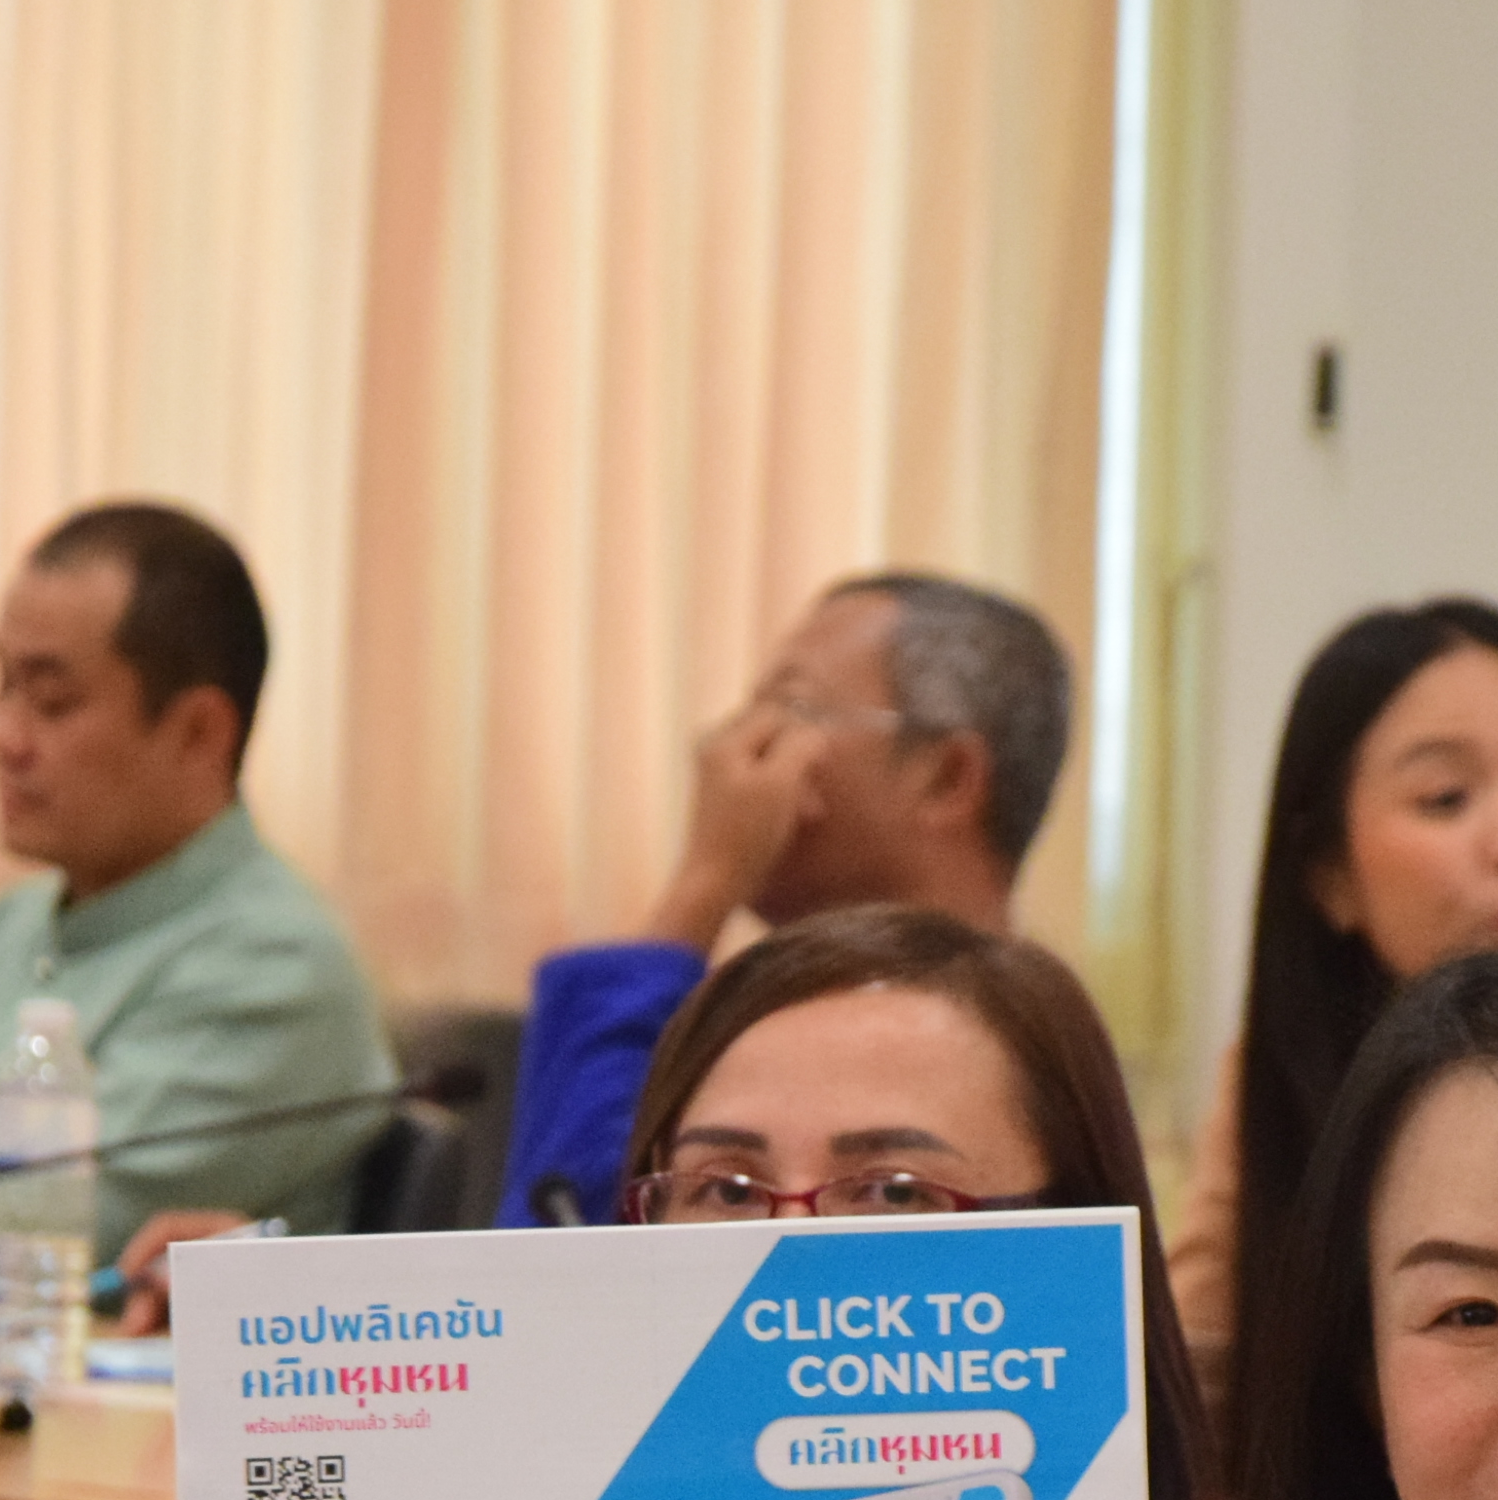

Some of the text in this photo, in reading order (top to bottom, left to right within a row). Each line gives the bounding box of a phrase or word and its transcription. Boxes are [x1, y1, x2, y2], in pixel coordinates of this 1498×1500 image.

[239, 1299, 504, 1346] แอปพลิเคชัน
[743, 1291, 1006, 1342] CLICK TO
[241, 1356, 469, 1409] คลิกชุมชน
[787, 1347, 1067, 1398] CONNECT
[789, 1426, 1002, 1475] คลิกชุมชน
